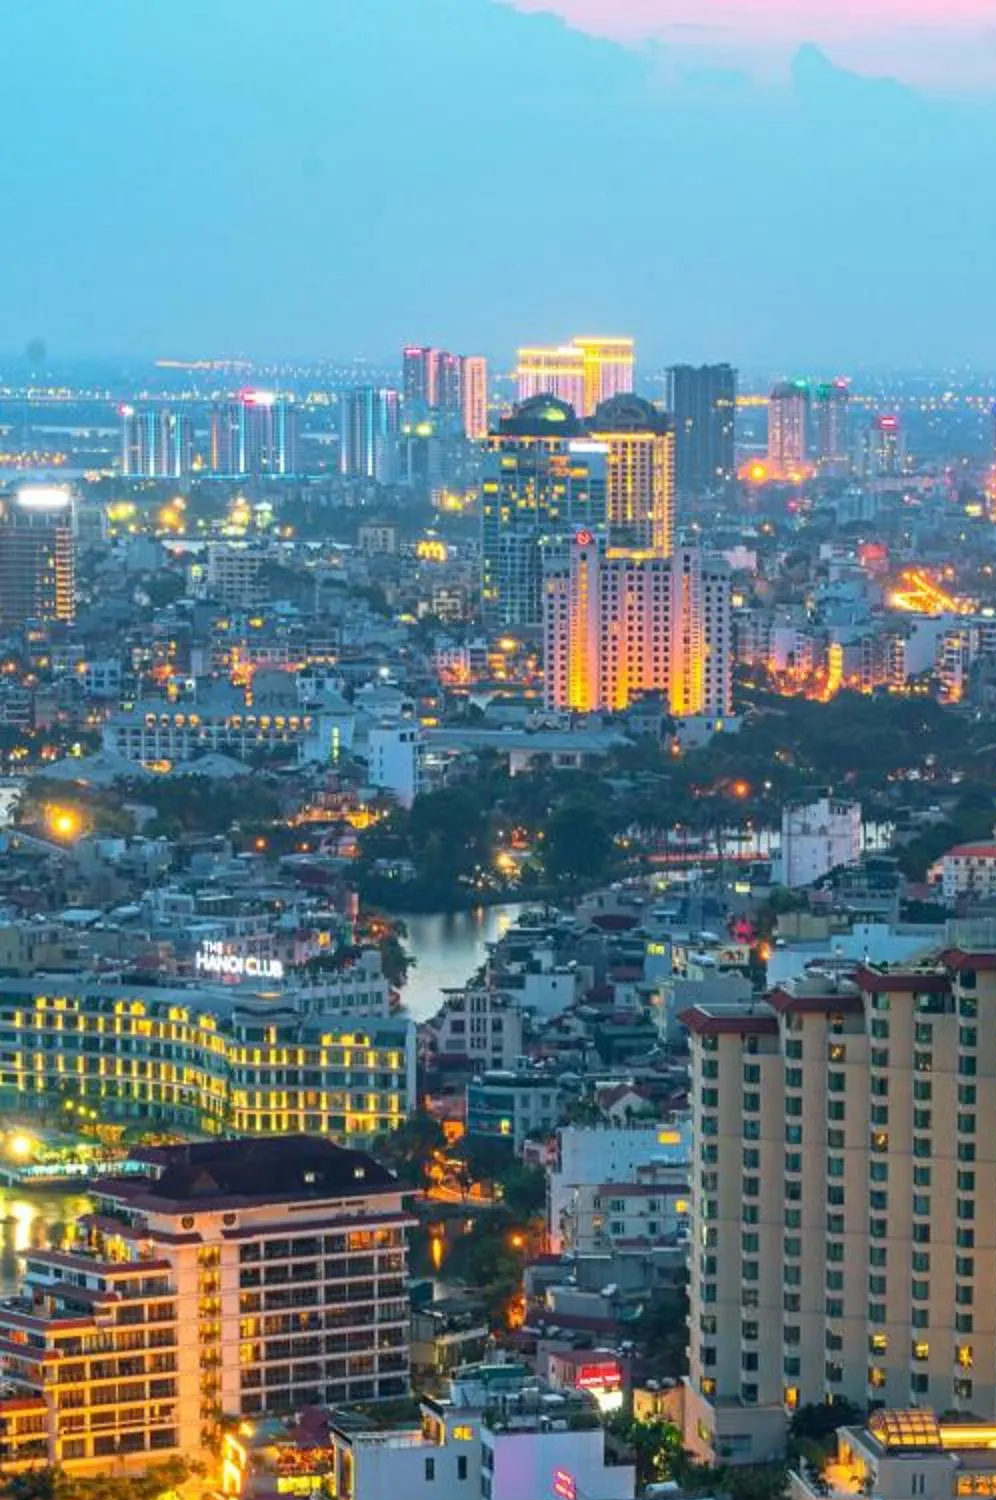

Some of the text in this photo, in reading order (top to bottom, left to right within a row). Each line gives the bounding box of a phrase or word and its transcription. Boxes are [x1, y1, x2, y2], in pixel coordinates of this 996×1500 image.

[202, 940, 223, 955] THE
[196, 951, 283, 978] HANOI CLUB
